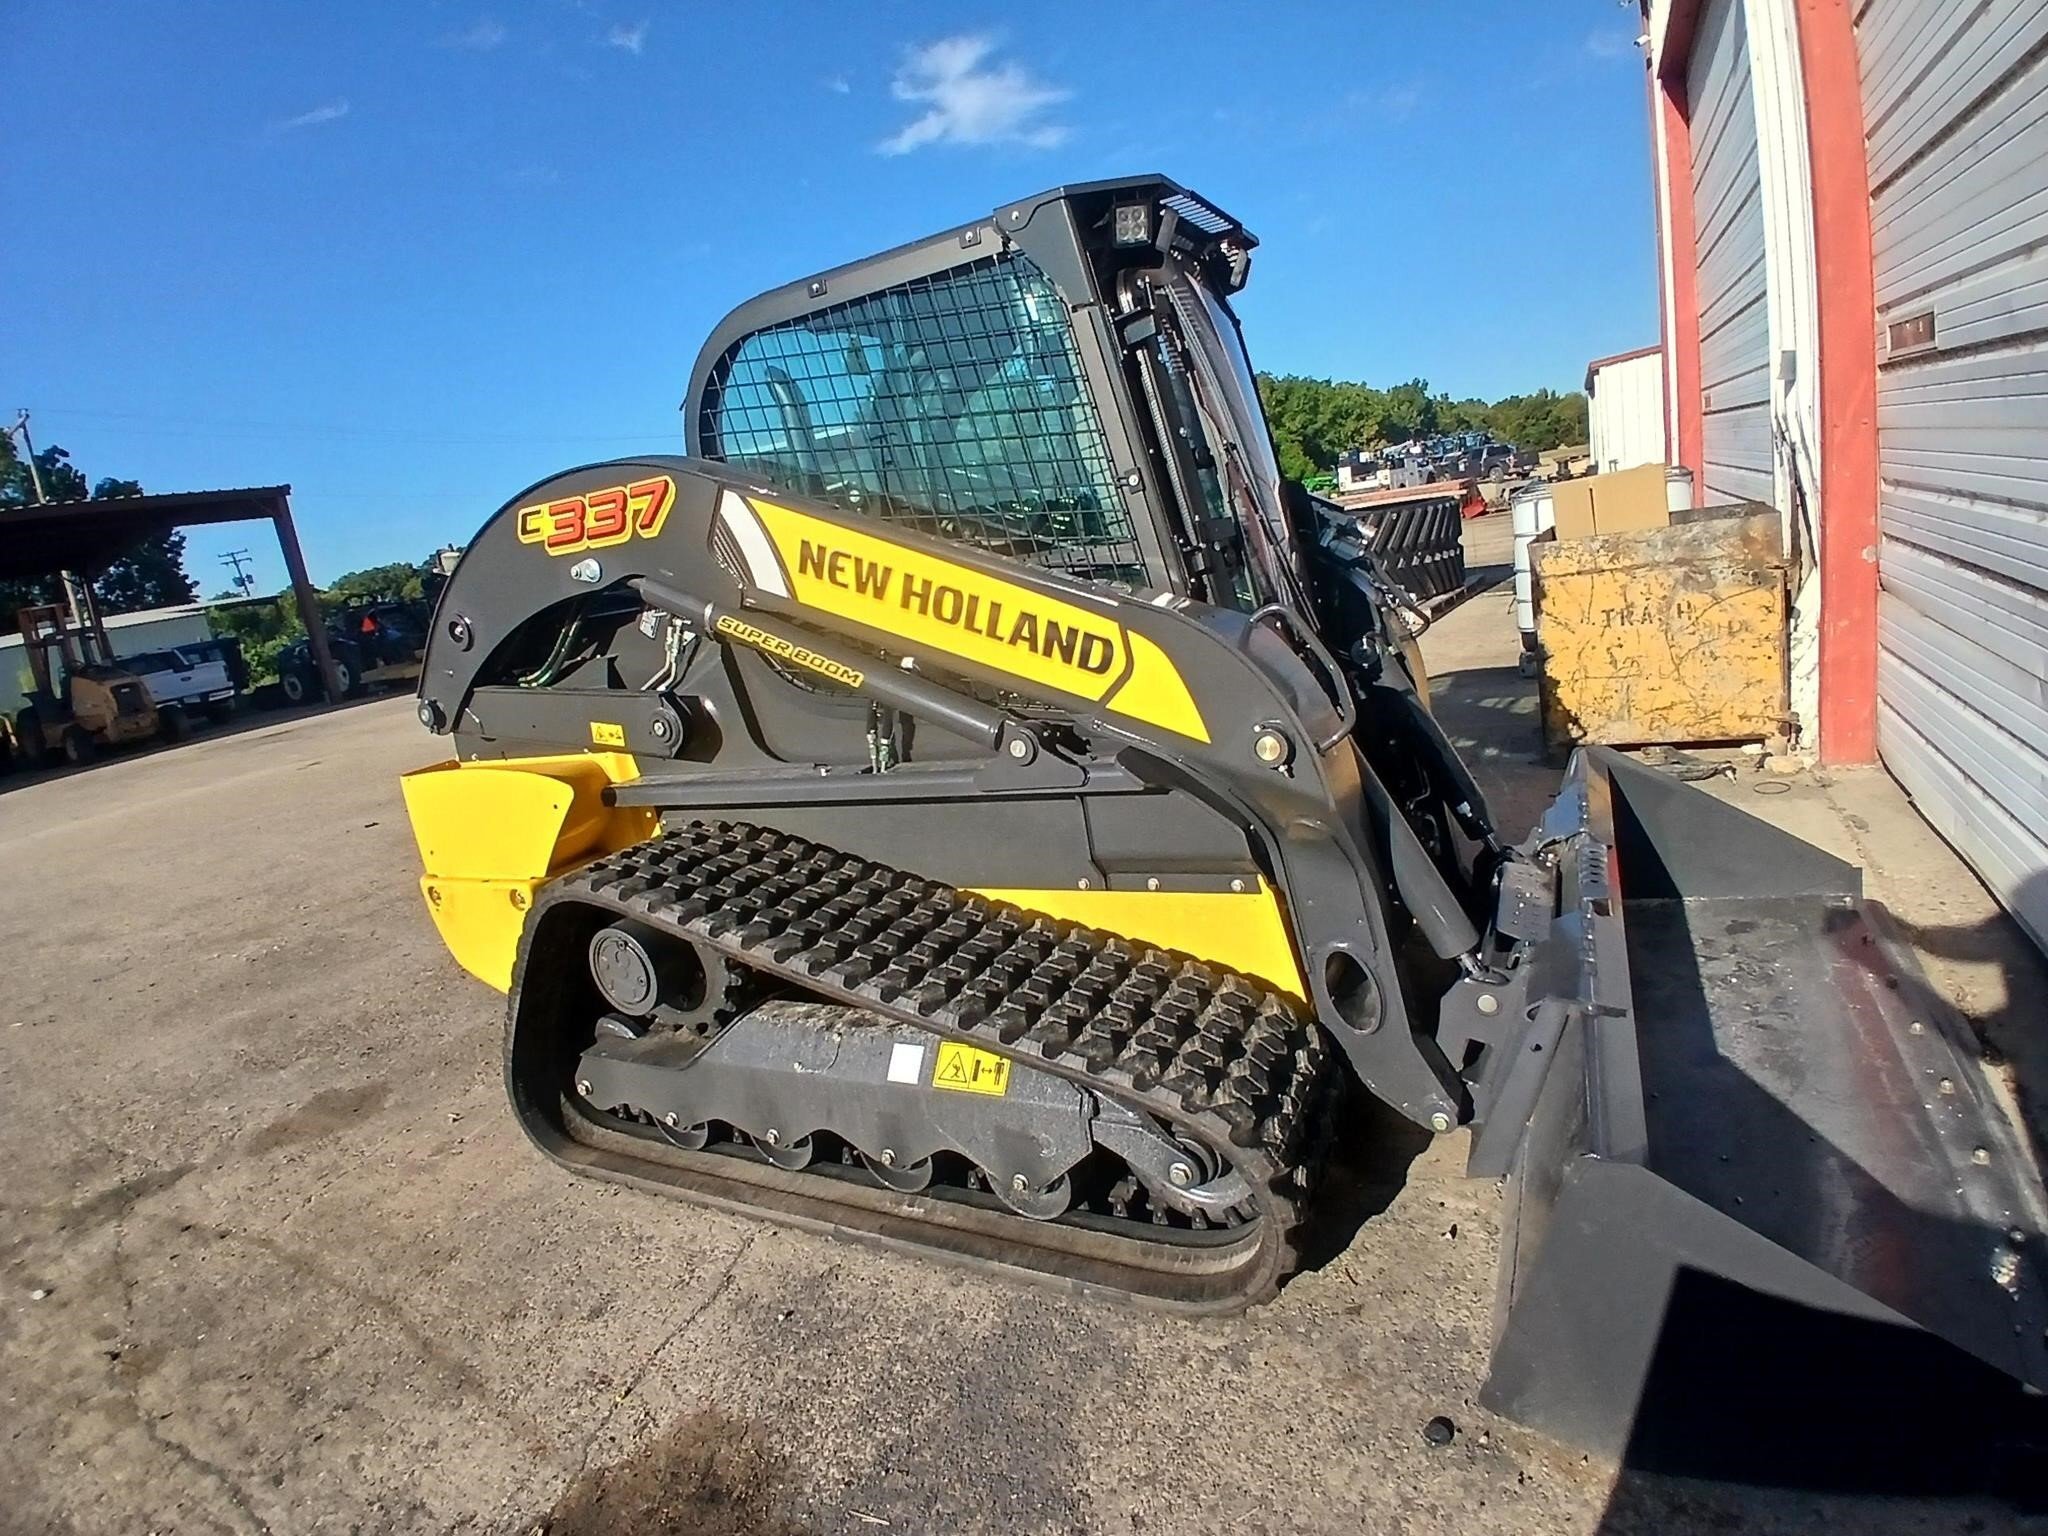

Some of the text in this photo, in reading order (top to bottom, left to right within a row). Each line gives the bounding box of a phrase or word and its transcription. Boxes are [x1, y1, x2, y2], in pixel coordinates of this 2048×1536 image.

[518, 477, 673, 552] C337
[798, 539, 1115, 675] NEW HOLLAND
[718, 616, 862, 685] SUPER BOOM
